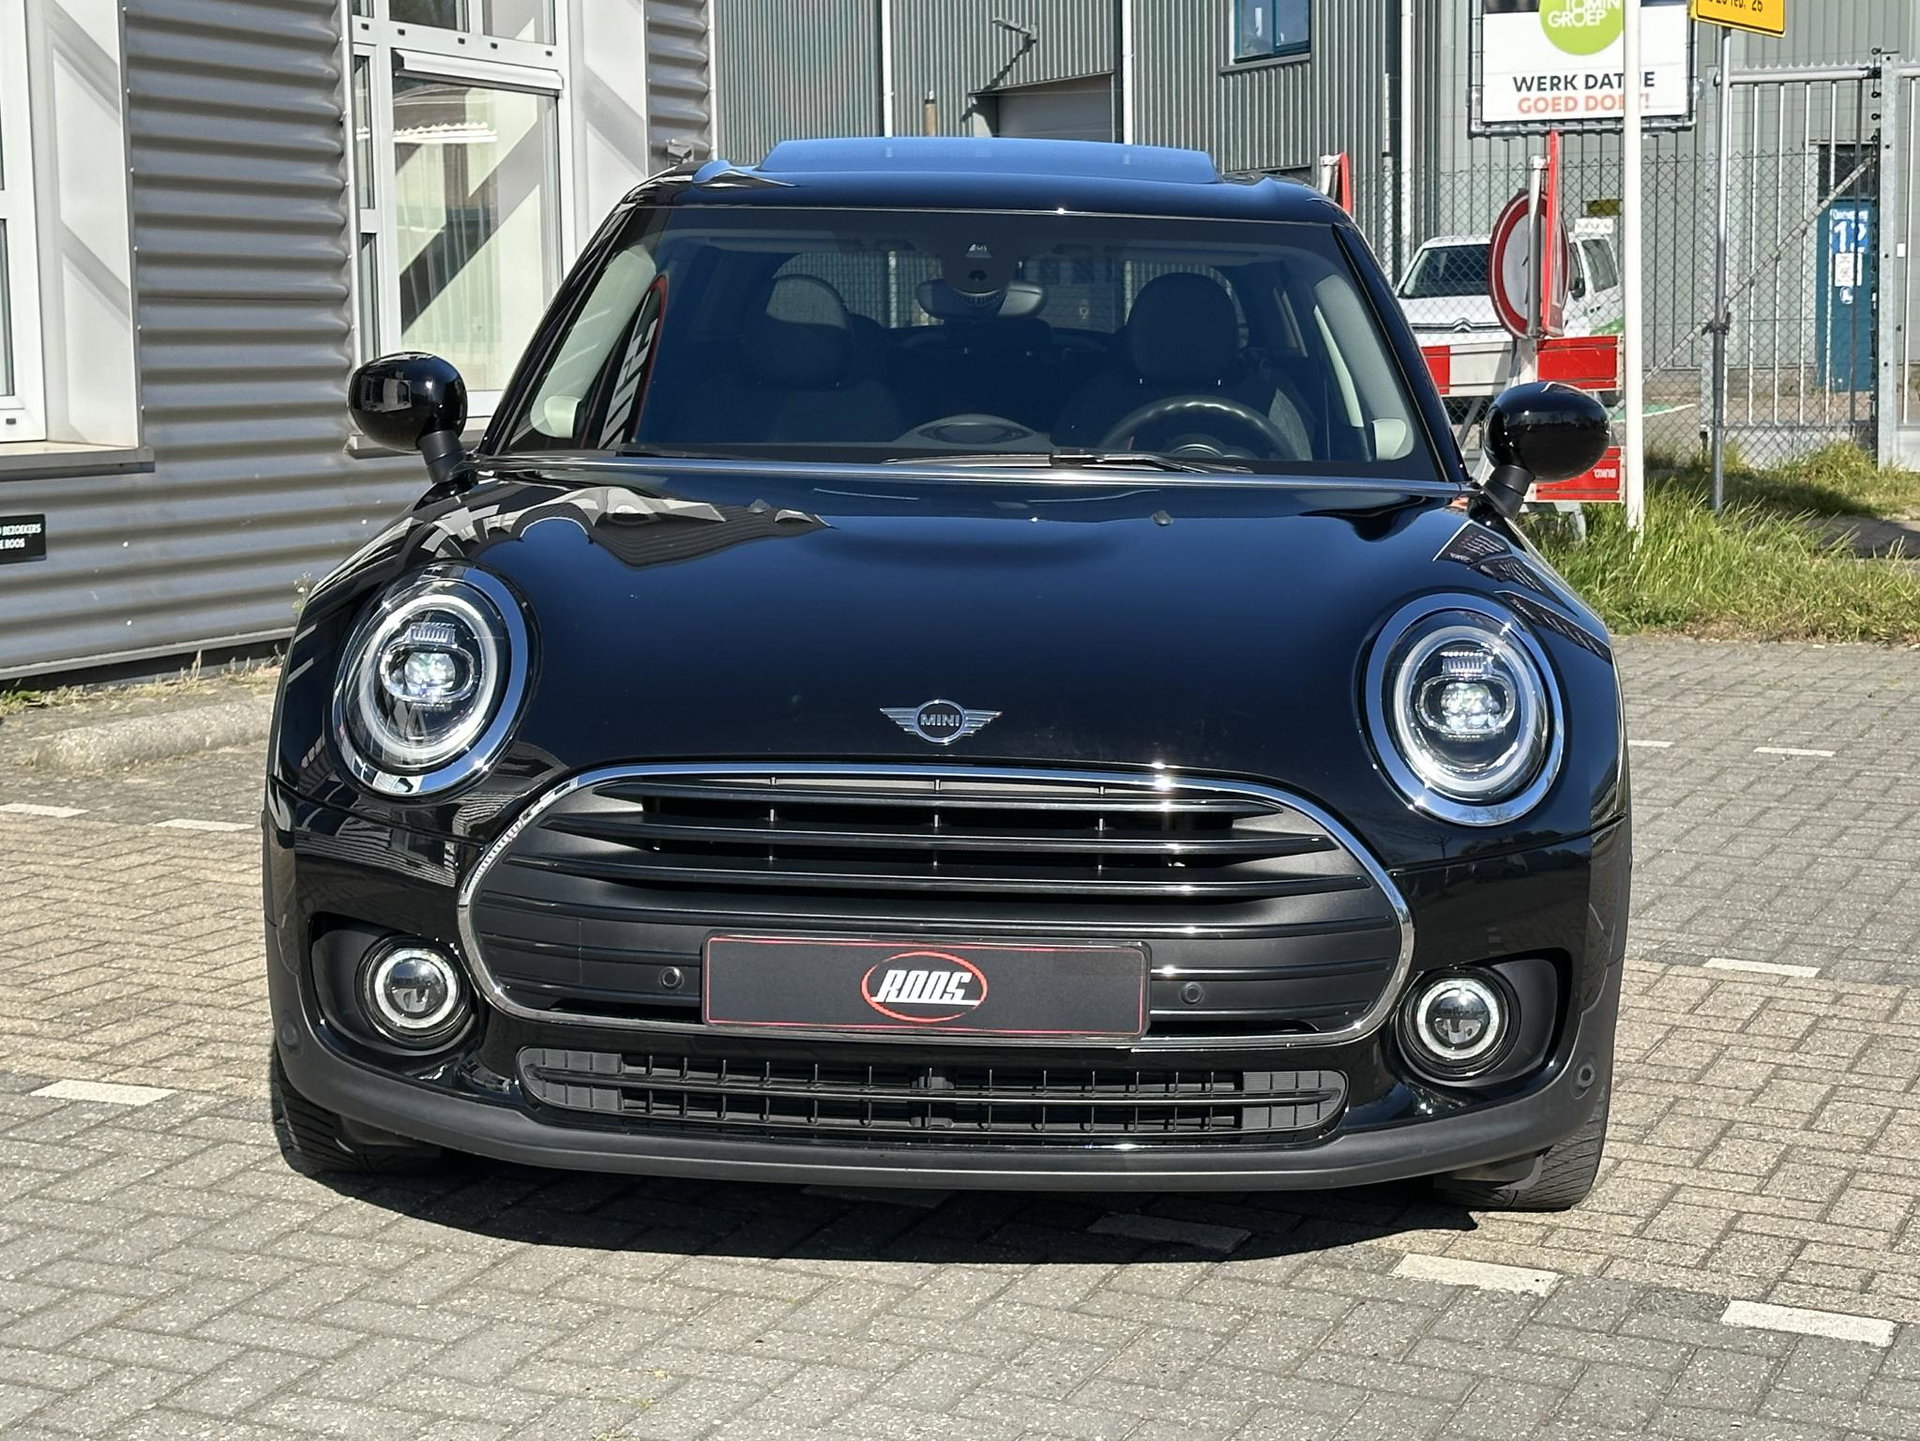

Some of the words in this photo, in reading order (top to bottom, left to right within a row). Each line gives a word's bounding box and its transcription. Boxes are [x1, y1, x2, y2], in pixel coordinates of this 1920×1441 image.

[1547, 11, 1606, 27] GROEP
[1513, 74, 1578, 92] WERK
[1518, 95, 1578, 114] GOED
[2, 523, 41, 536] BEZOEKERS
[5, 538, 25, 549] ROOS
[920, 714, 960, 727] MINI
[873, 969, 980, 1005] ROOS
